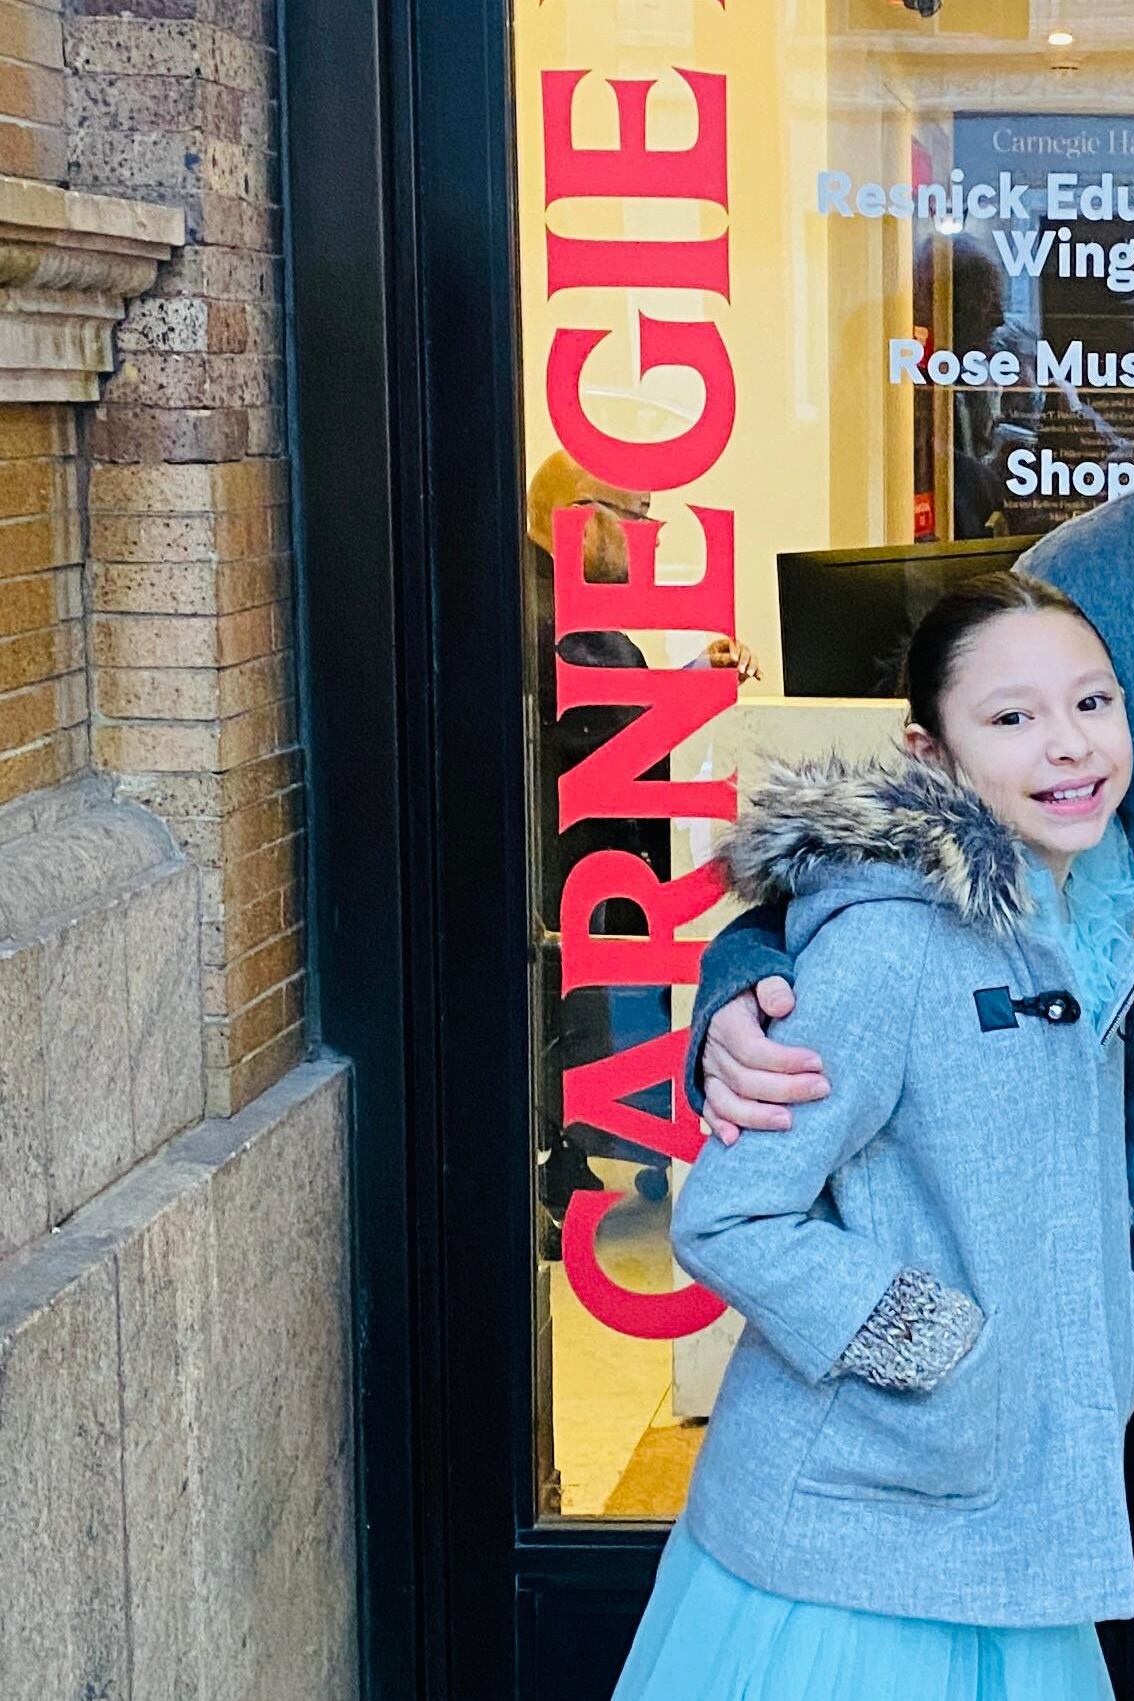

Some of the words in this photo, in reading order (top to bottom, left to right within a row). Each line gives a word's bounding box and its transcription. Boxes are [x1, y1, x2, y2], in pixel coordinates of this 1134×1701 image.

[992, 127, 1100, 159] Carnegie
[816, 168, 1030, 220] Resnick
[888, 338, 1020, 387] Rose
[541, 66, 737, 1340] CARNEGIE
